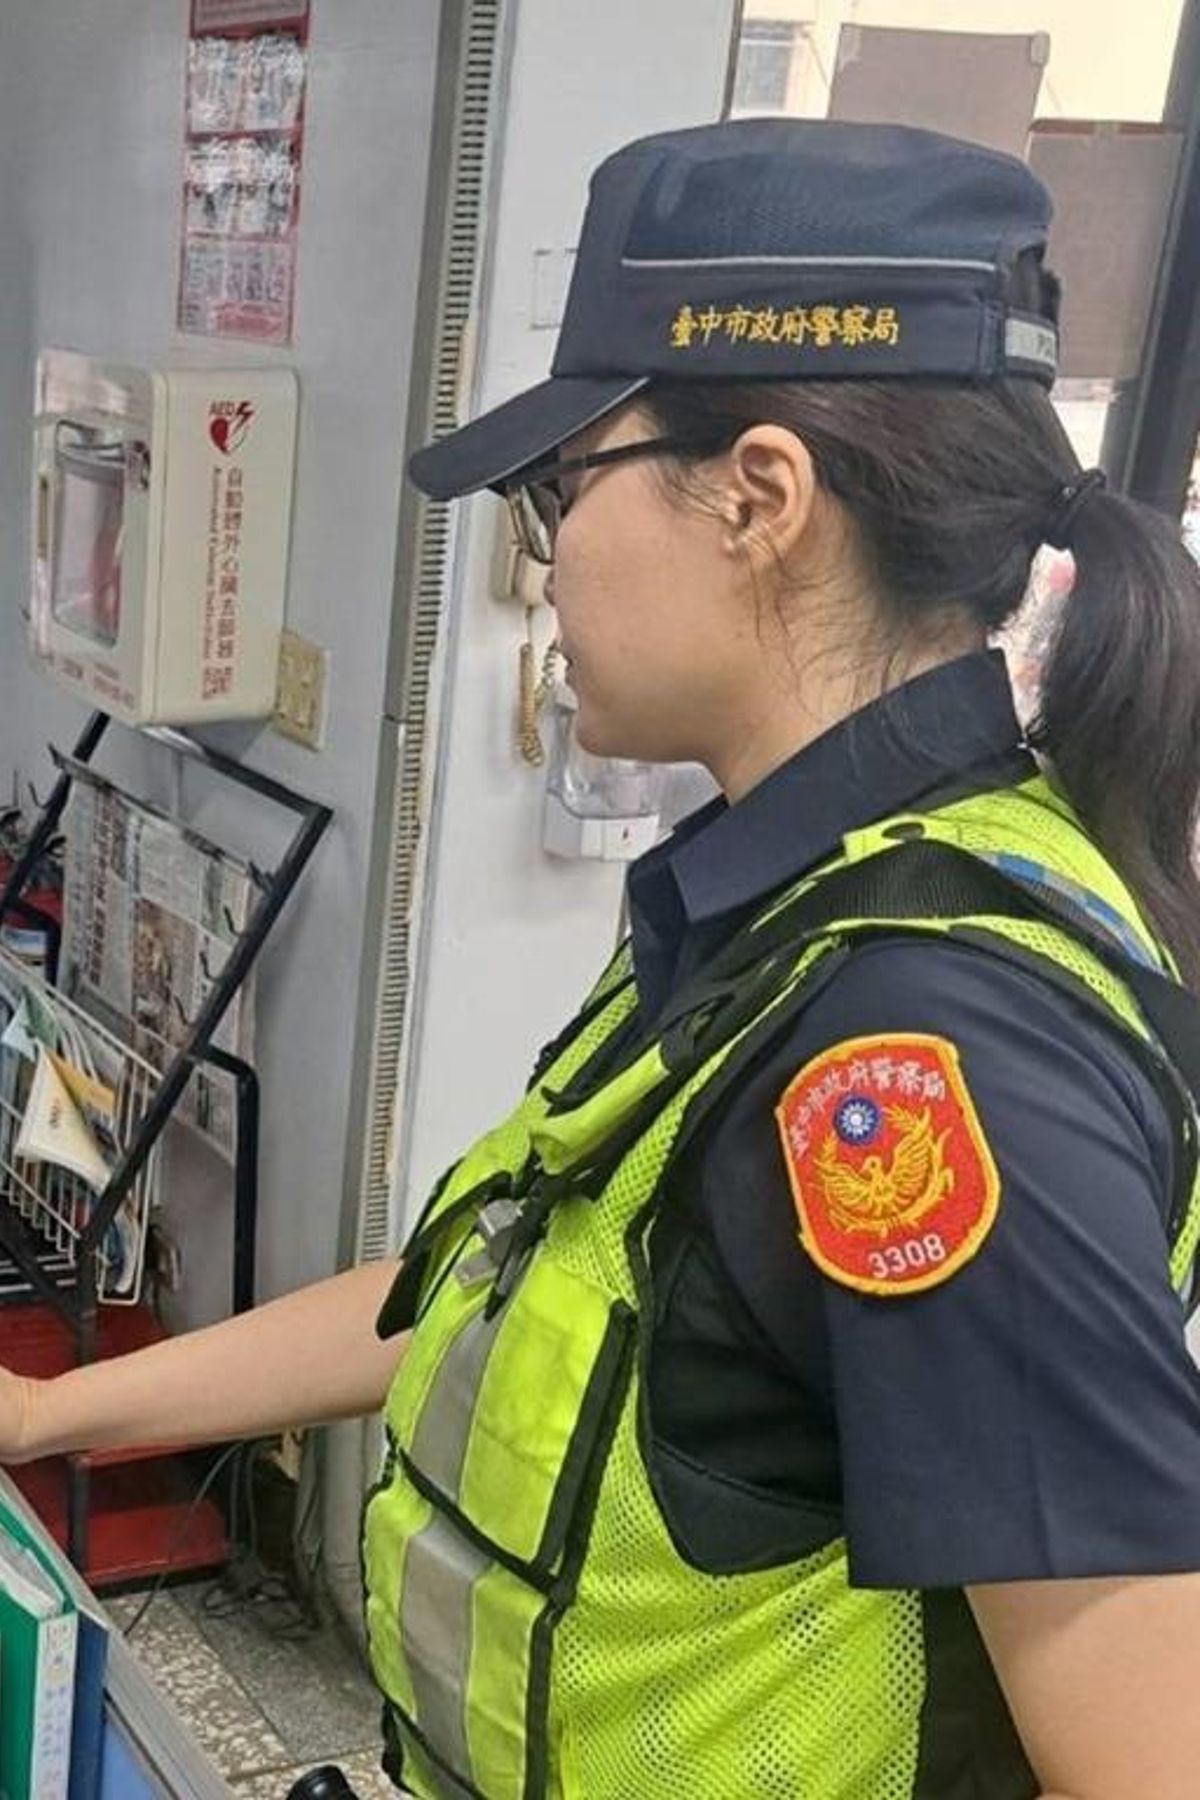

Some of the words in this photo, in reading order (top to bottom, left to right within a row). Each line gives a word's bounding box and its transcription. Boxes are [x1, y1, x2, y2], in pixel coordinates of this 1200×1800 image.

[670, 304, 900, 347] 臺中市政府警察局
[208, 399, 236, 416] AED
[868, 1233, 947, 1279] 3308
